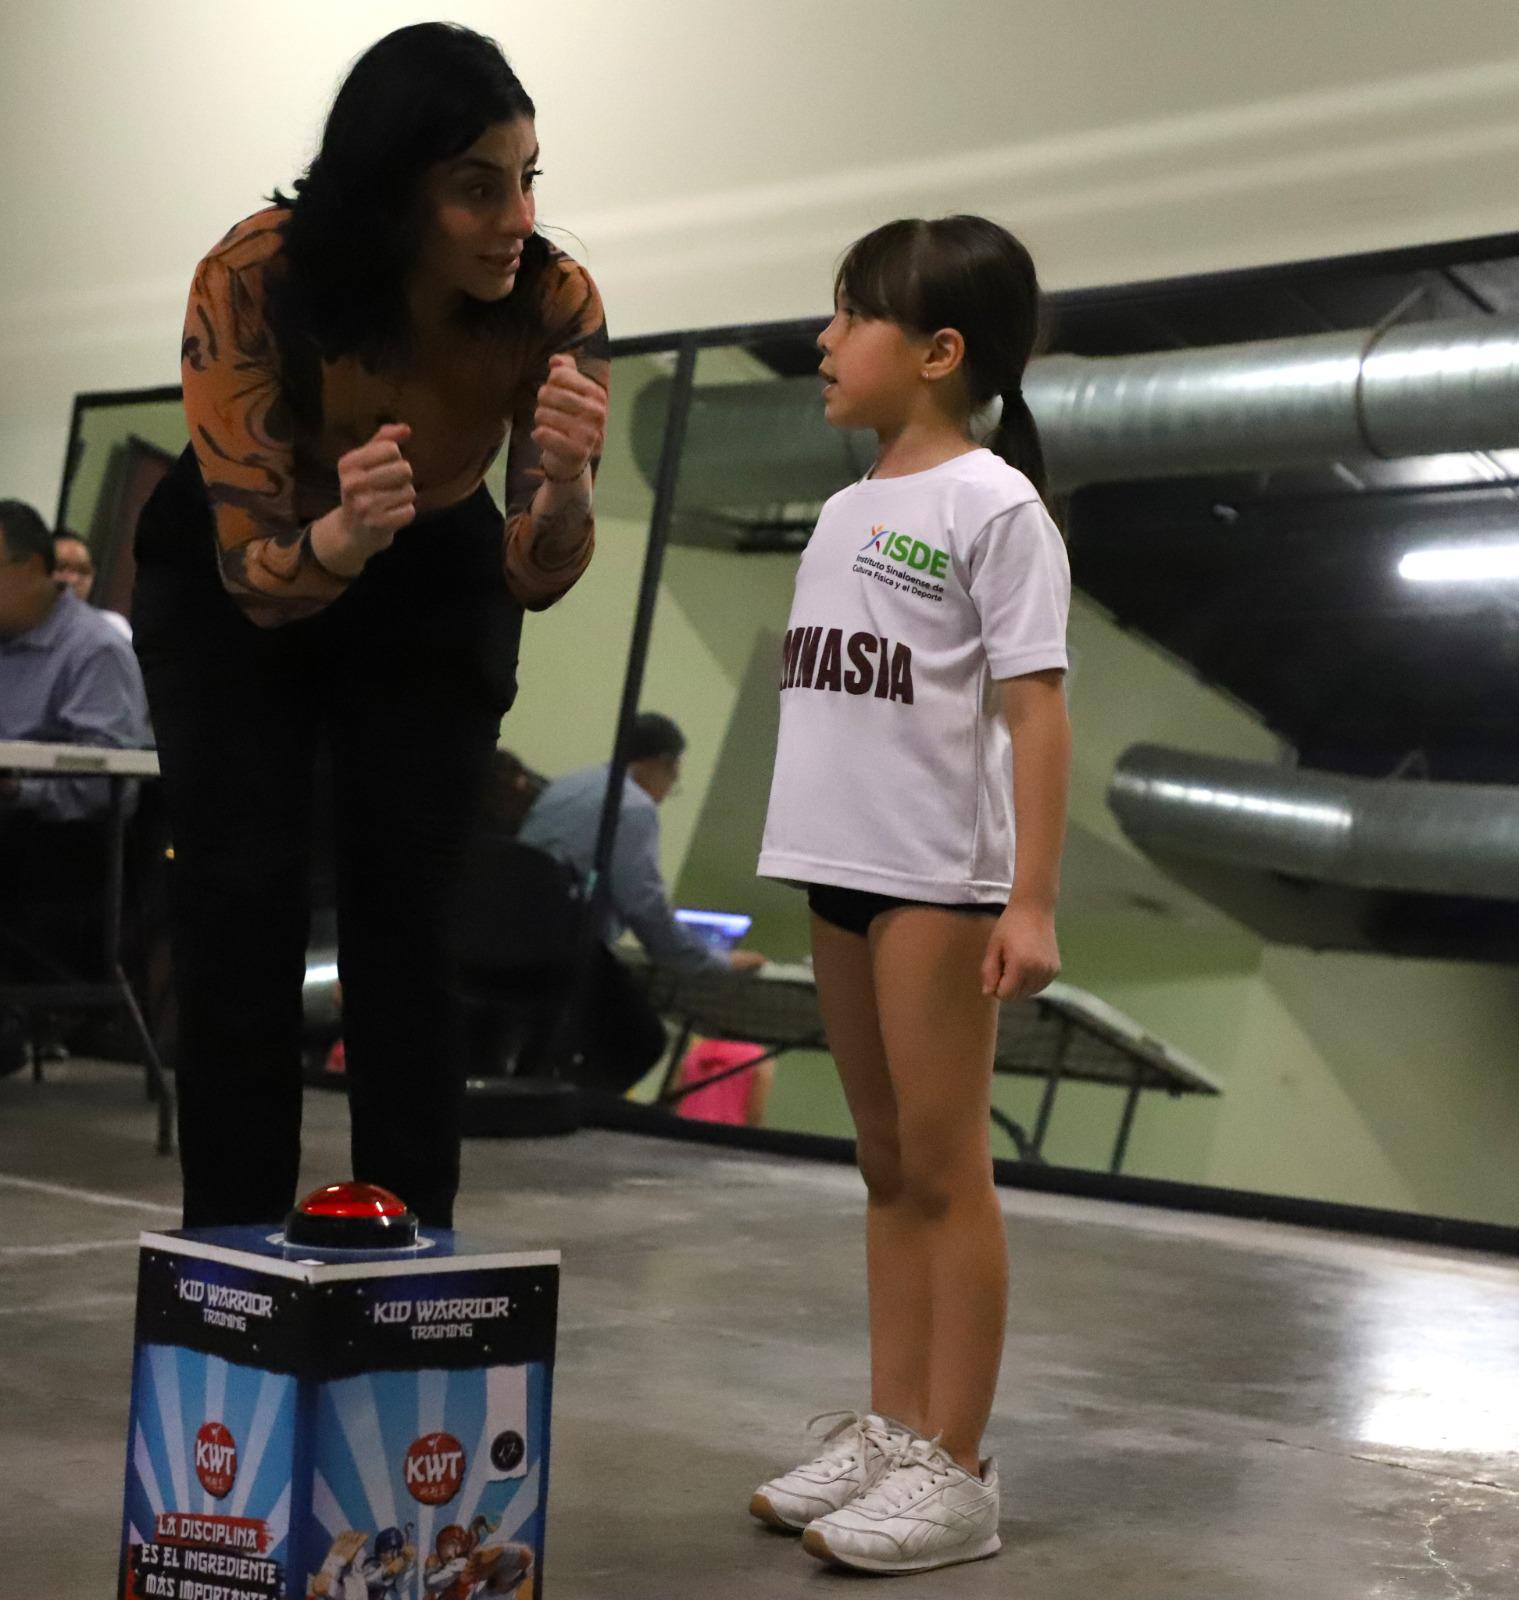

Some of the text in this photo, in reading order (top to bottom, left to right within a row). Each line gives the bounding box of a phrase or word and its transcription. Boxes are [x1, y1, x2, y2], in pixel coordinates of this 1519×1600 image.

[882, 531, 950, 579] ISDE
[852, 564, 873, 576] Cultura
[894, 581, 902, 590] y
[911, 586, 943, 602] Deporte
[856, 554, 945, 593] Instituto Sinaloense de
[179, 1278, 273, 1319] KID WARRIOR
[374, 1297, 509, 1324] KID WARRIOR
[203, 1308, 247, 1332] TRAINING
[411, 1323, 473, 1340] TRAINING
[197, 1440, 235, 1476] KWT
[407, 1451, 462, 1484] KWT
[158, 1515, 257, 1549] LA DISCIPLINA
[141, 1543, 277, 1584] ES EL INGREDIENTE
[145, 1570, 175, 1597] MÁS
